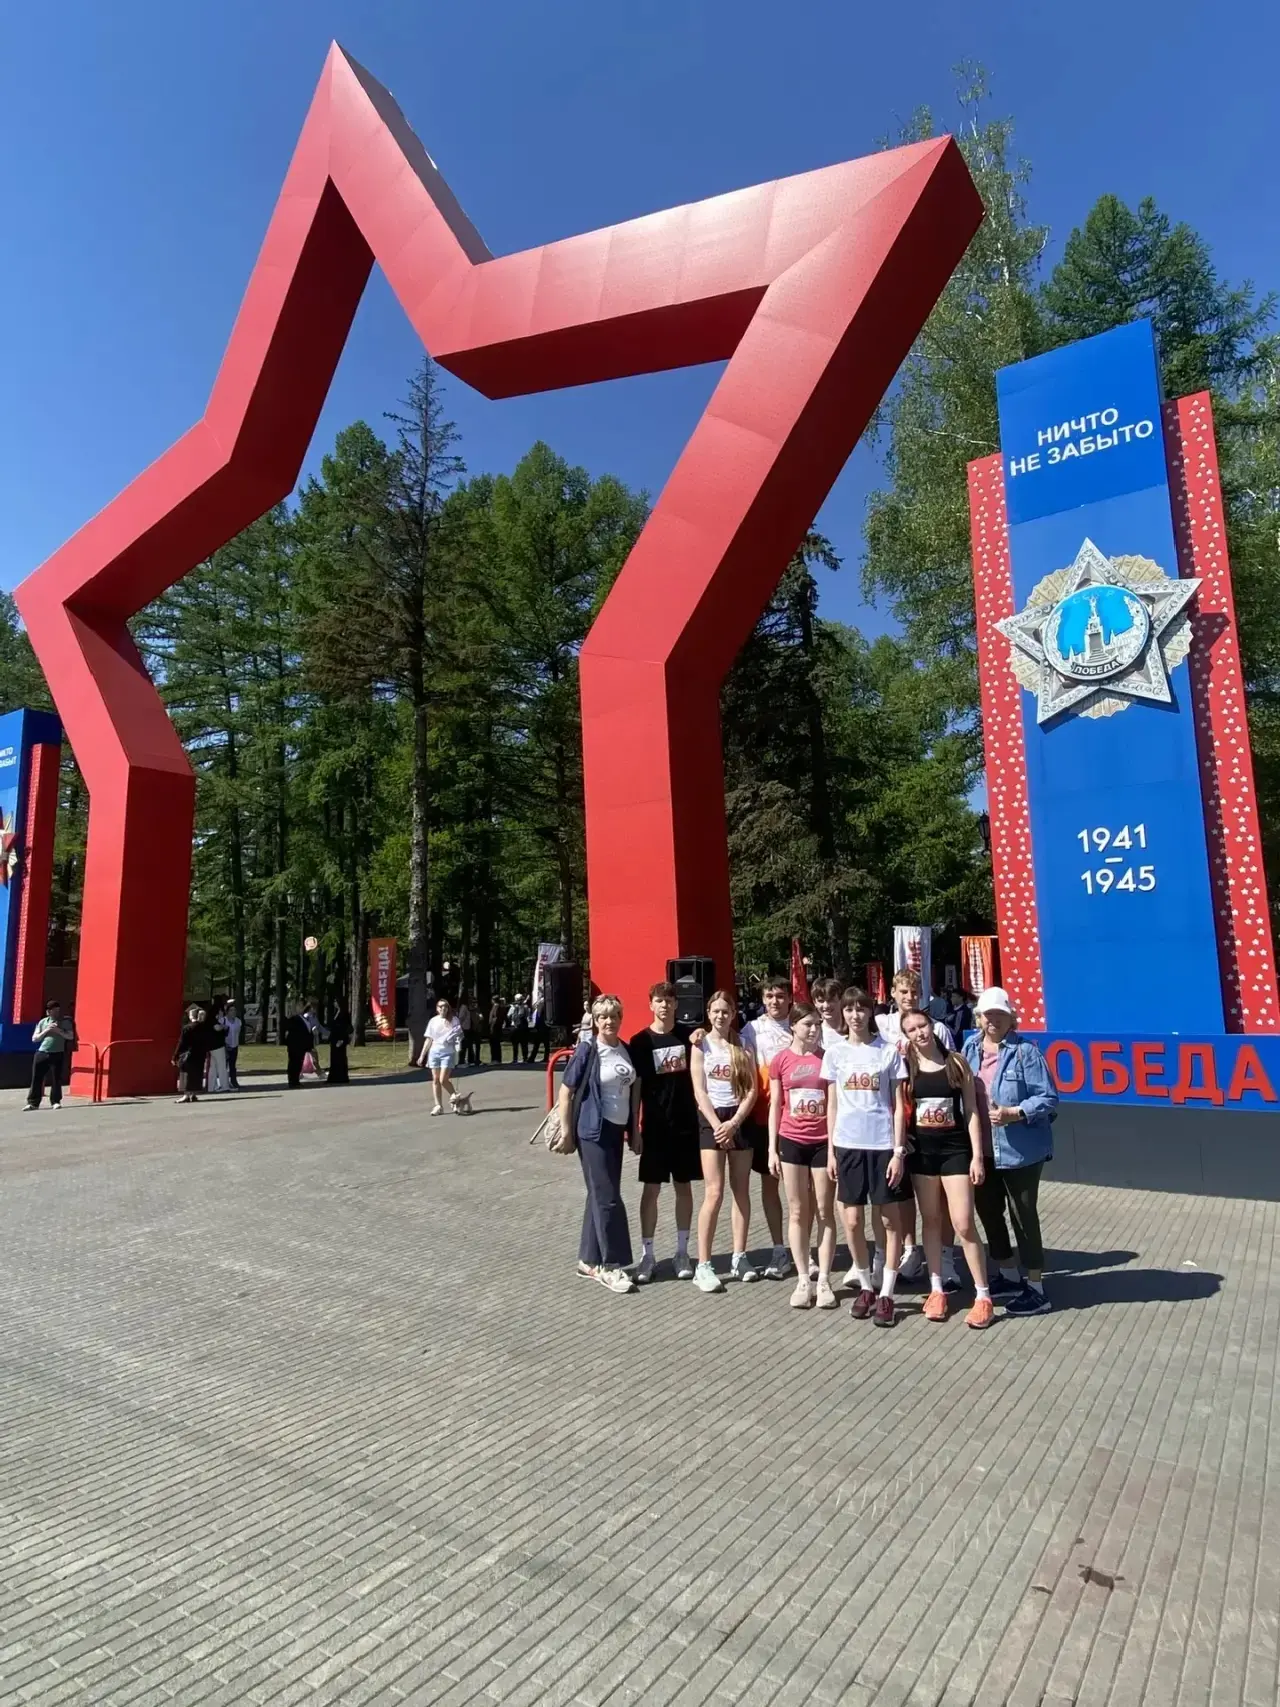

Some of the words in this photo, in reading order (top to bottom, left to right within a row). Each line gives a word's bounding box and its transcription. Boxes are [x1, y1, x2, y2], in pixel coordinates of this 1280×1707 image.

[1037, 407, 1119, 446] НИЧТО
[1010, 453, 1041, 476] НЕ
[1047, 420, 1154, 464] ЗАБЫТО
[1074, 660, 1119, 675] ПОБЕДА
[1077, 823, 1146, 853] 1941
[1081, 865, 1156, 894] 1945
[711, 1064, 731, 1078] 46
[1044, 1039, 1279, 1106] ОБЕДА
[796, 1099, 818, 1114] 46
